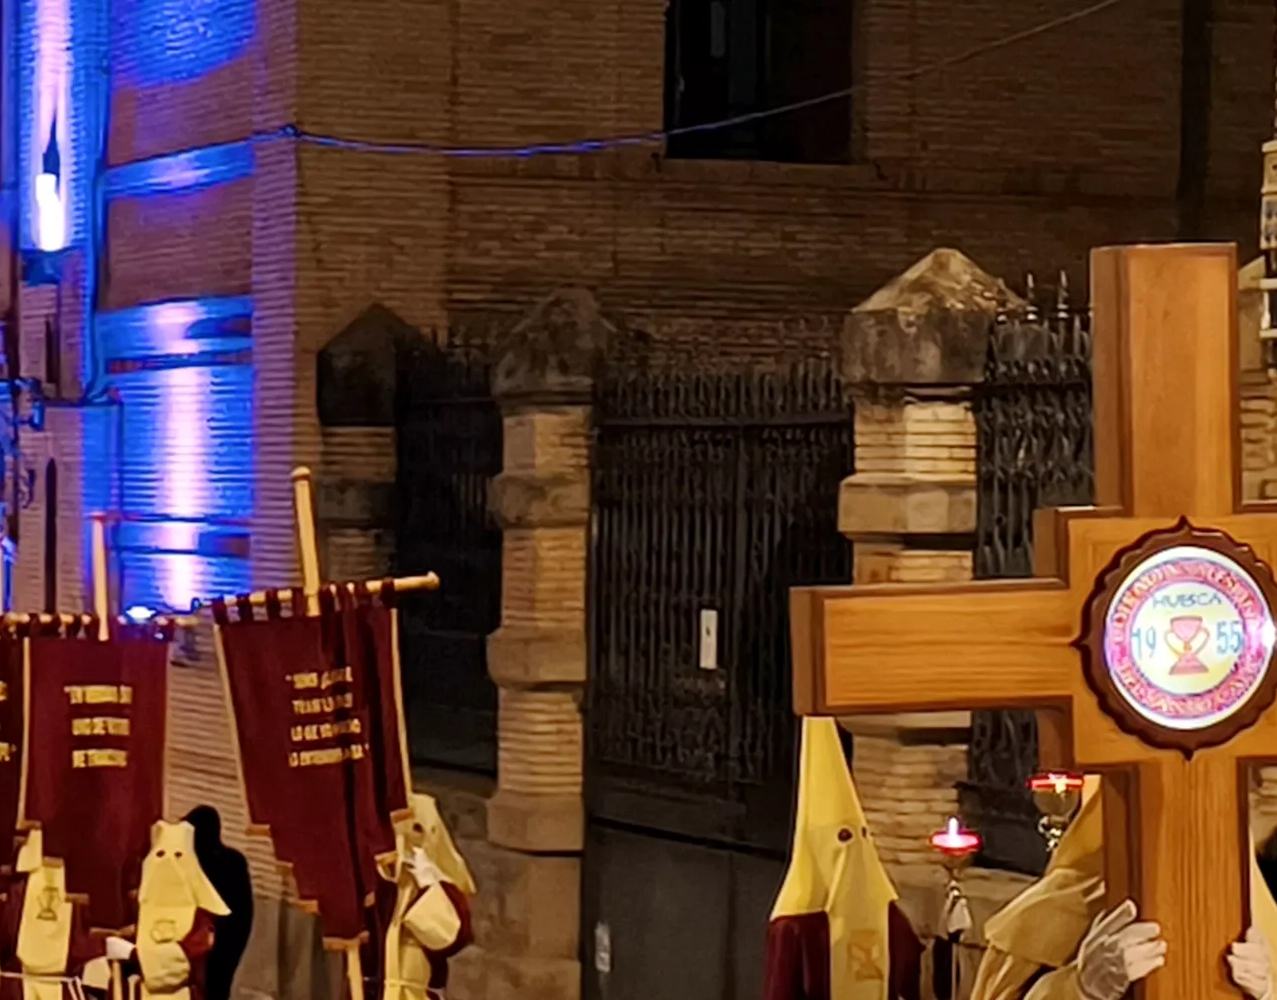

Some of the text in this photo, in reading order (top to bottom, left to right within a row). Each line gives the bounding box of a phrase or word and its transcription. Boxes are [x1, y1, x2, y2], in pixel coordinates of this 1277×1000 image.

[1152, 590, 1223, 609] HUESCA
[1130, 620, 1245, 659] 19 55
